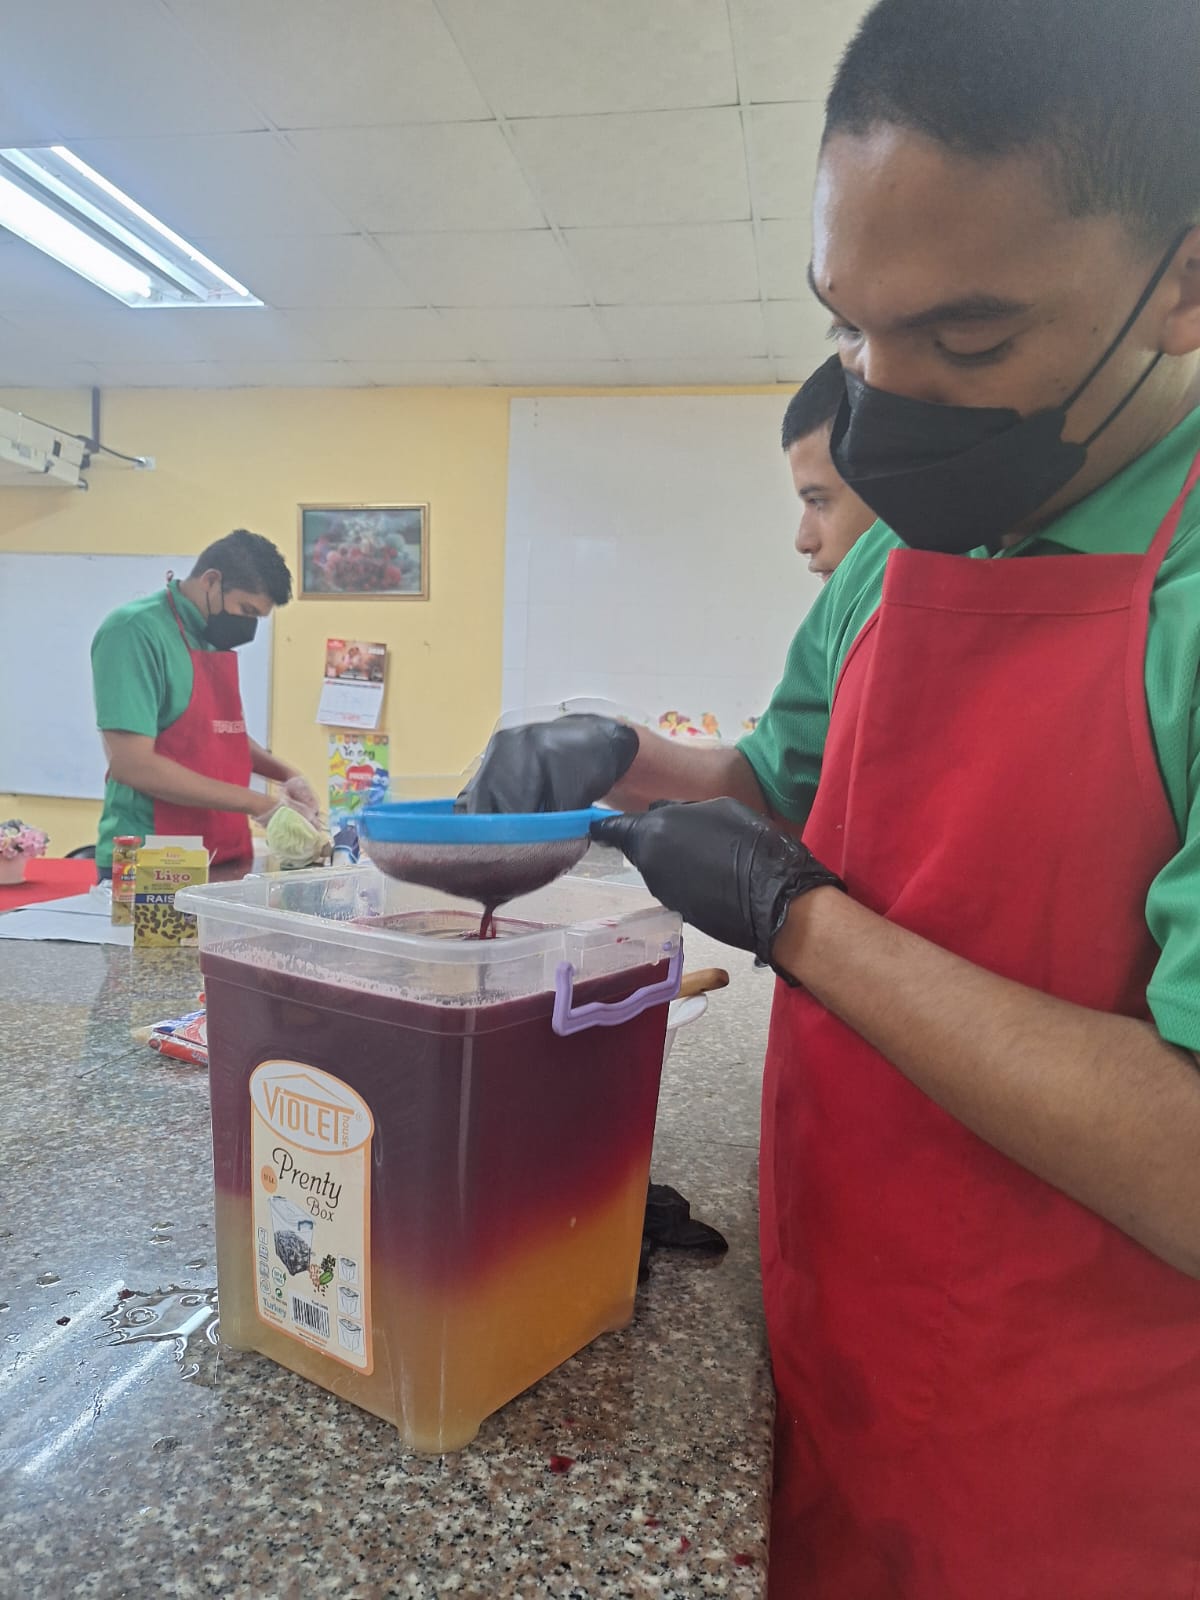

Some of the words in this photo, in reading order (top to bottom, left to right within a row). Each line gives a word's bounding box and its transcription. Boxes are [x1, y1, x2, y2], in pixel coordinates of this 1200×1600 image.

[155, 870, 191, 883] Ligo
[272, 1147, 343, 1209] Prenty
[306, 1196, 336, 1222] Box
[263, 1297, 287, 1319] Turkey
